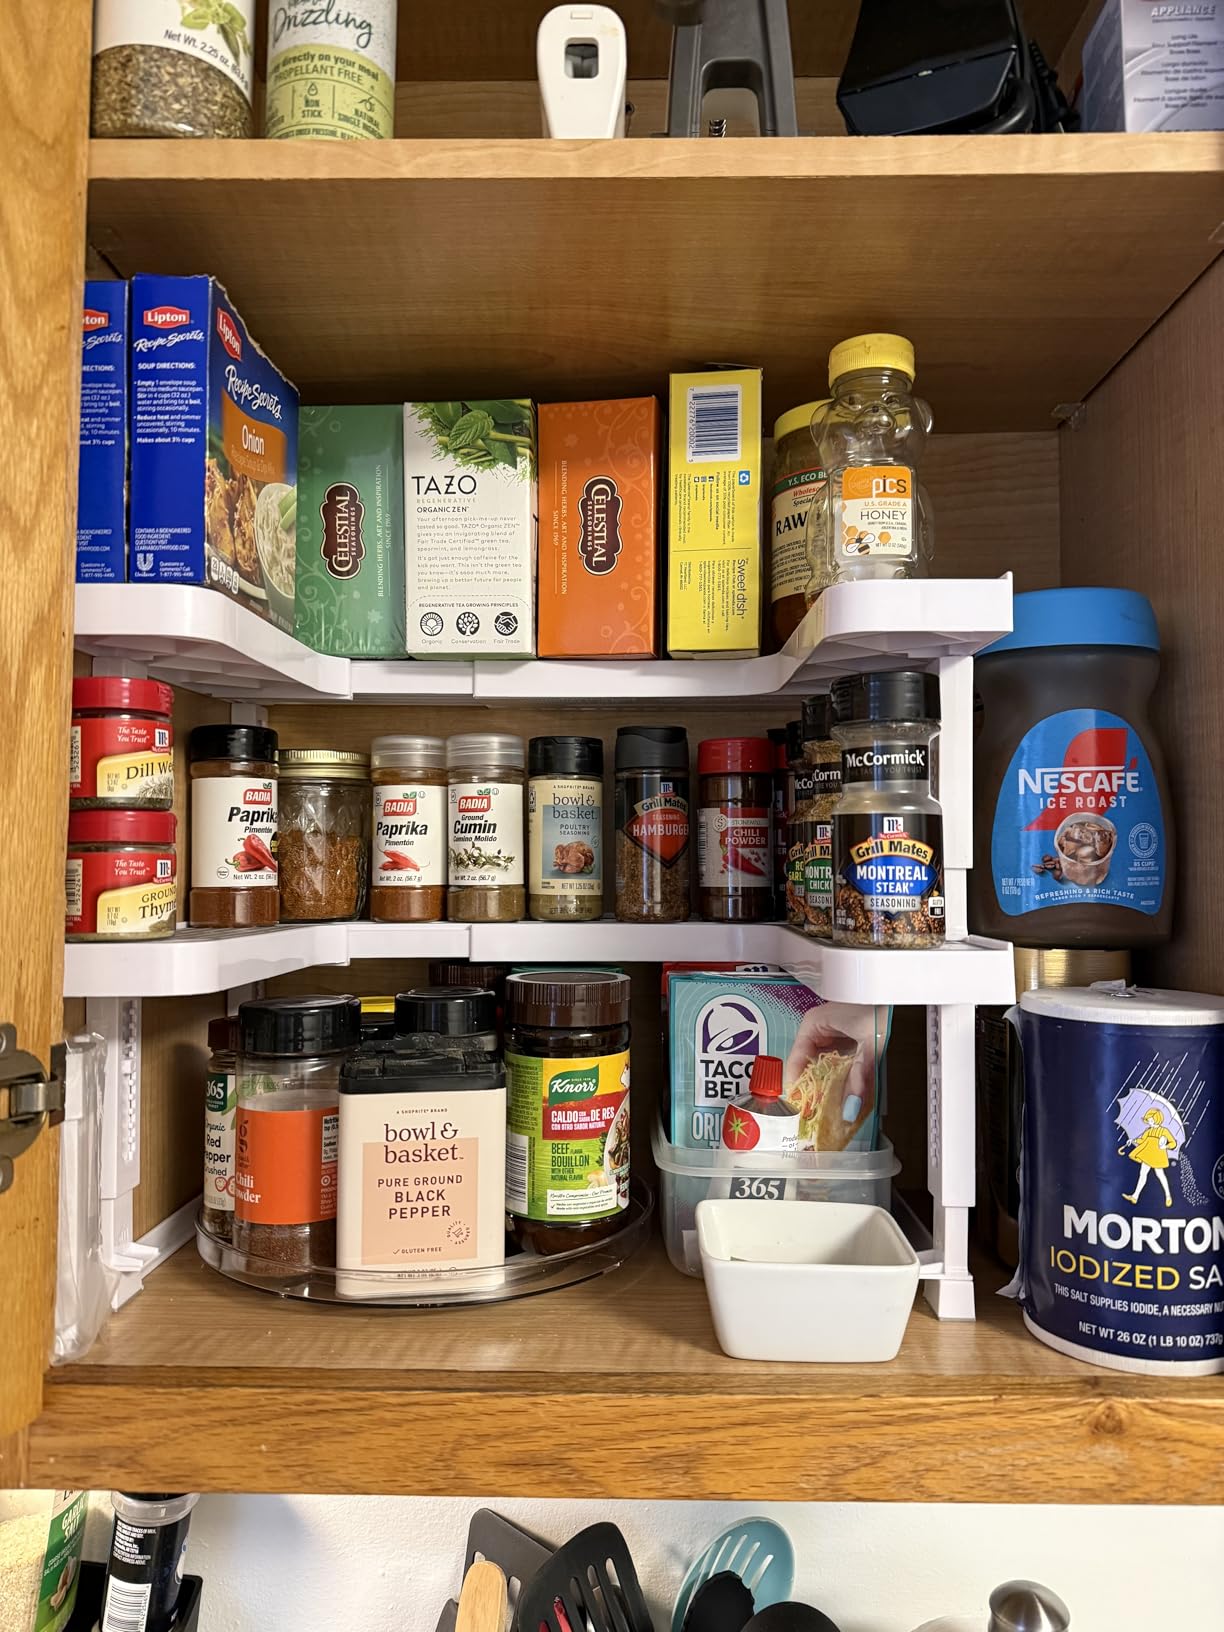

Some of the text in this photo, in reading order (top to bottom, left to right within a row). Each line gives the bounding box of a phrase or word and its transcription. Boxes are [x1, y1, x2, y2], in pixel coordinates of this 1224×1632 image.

[1151, 5, 1215, 17] APPLIANCE
[164, 30, 181, 41] Net
[282, 52, 315, 67] directly
[318, 53, 330, 61] on
[334, 55, 356, 68] your
[337, 68, 363, 84] FREE
[302, 110, 322, 118] STICK
[147, 311, 187, 323] Lipton
[133, 330, 205, 353] Recipe Secrets
[219, 315, 241, 354] Lipton
[225, 364, 282, 418] Recipe Secrets
[242, 424, 264, 456] Onion
[411, 475, 477, 495] TAZO
[801, 473, 815, 483] ECO
[375, 465, 383, 507] INSPIRATION
[872, 475, 907, 498] pics
[860, 510, 907, 521] HONEY
[333, 490, 352, 572] CELESTIAL
[591, 484, 611, 567] CELESTIAL
[776, 512, 808, 536] RAW
[737, 559, 748, 616] sweet dish
[117, 726, 147, 736] The Taste
[117, 734, 131, 743] You
[846, 749, 926, 769] McCormick
[126, 761, 155, 780] Dill
[245, 790, 271, 802] BADIA
[552, 793, 595, 806] bowl &
[1040, 796, 1127, 809] ICE ROAST
[384, 802, 414, 813] BADIA
[459, 798, 487, 809] BADIA
[641, 798, 662, 811] Grill
[461, 814, 485, 822] Ground
[376, 821, 428, 838] Paprika
[454, 820, 497, 834] Cumin
[385, 838, 414, 846] Pimentón
[725, 837, 767, 845] POWDER
[857, 842, 885, 859] Grill
[114, 860, 144, 869] The Taste
[114, 867, 128, 877] You
[857, 865, 929, 881] MONTREAL
[1035, 889, 1083, 901] REFRESHING
[1093, 888, 1111, 896] RICH
[1112, 890, 1135, 900] TASTE
[870, 897, 916, 909] SEASONING
[551, 1079, 596, 1093] Knorr
[551, 1106, 615, 1123] CALDO DE RES
[384, 1122, 459, 1142] bowl &
[551, 1143, 570, 1154] BEEF
[551, 1155, 589, 1168] BOUILLON
[378, 1175, 463, 1188] PURE GROUND
[735, 1177, 780, 1200] 365
[395, 1189, 446, 1203] BLACK
[389, 1205, 451, 1220] PEPPER
[1050, 1246, 1224, 1293] IODIZED SA
[1054, 1283, 1213, 1317] THIS SALT SUPPLIES IODIDE, A NECESSARY
[1078, 1321, 1097, 1336] NET
[1098, 1326, 1115, 1339] WT
[1117, 1331, 1131, 1343] 26
[1132, 1333, 1147, 1345] OZ
[1148, 1335, 1157, 1348] (1
[1160, 1336, 1174, 1347] LB
[1175, 1336, 1187, 1347] 10
[1188, 1335, 1204, 1348] OZ)
[64, 1513, 81, 1543] SALT
